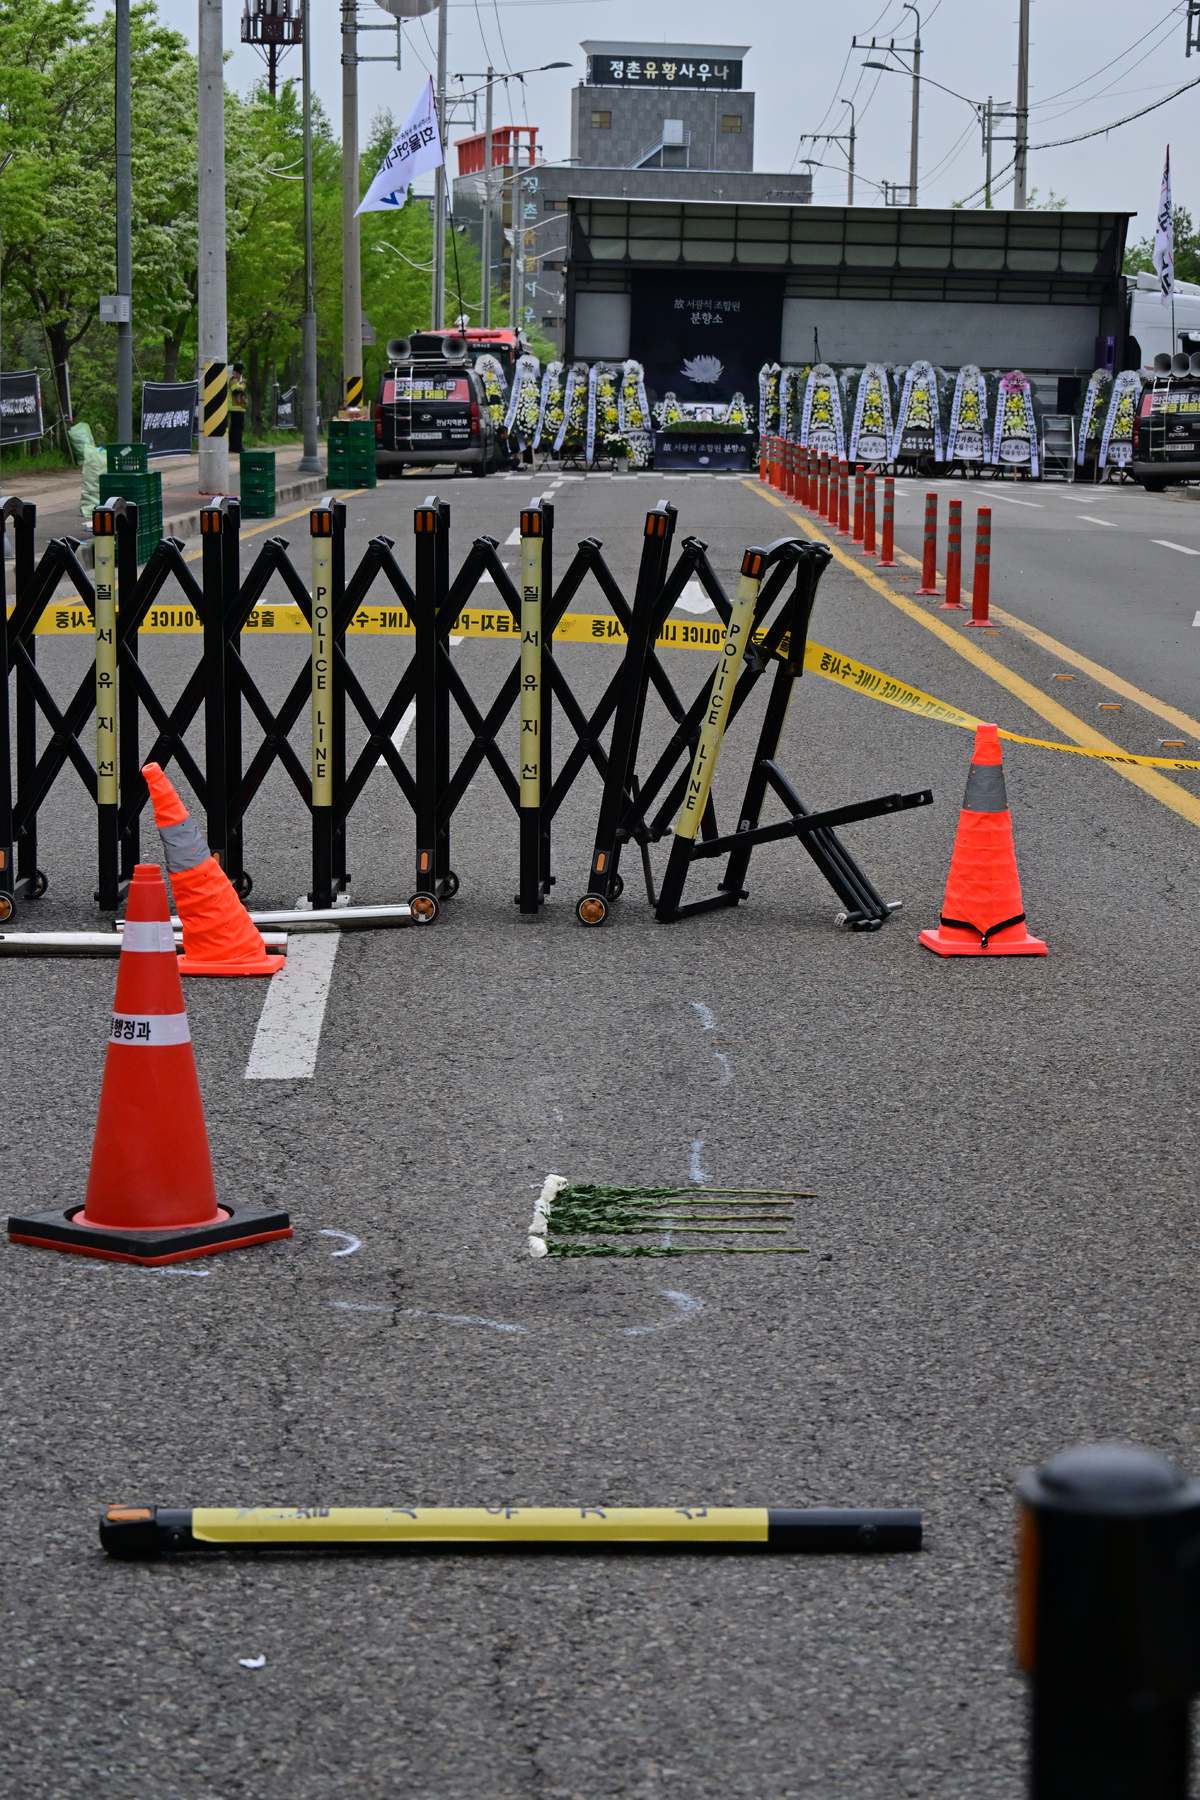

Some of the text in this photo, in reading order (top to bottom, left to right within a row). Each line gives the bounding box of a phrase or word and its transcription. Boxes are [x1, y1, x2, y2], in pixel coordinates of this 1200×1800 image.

[610, 60, 729, 82] 정촌유황사우나
[690, 312, 723, 325] 분향소
[713, 301, 740, 312] 조합원
[723, 444, 746, 453] 분향소
[96, 584, 114, 777] 질서유지선
[315, 587, 328, 778] POLICE LINE
[521, 586, 539, 780] 질서유지선
[685, 623, 741, 811] POLICE LINE
